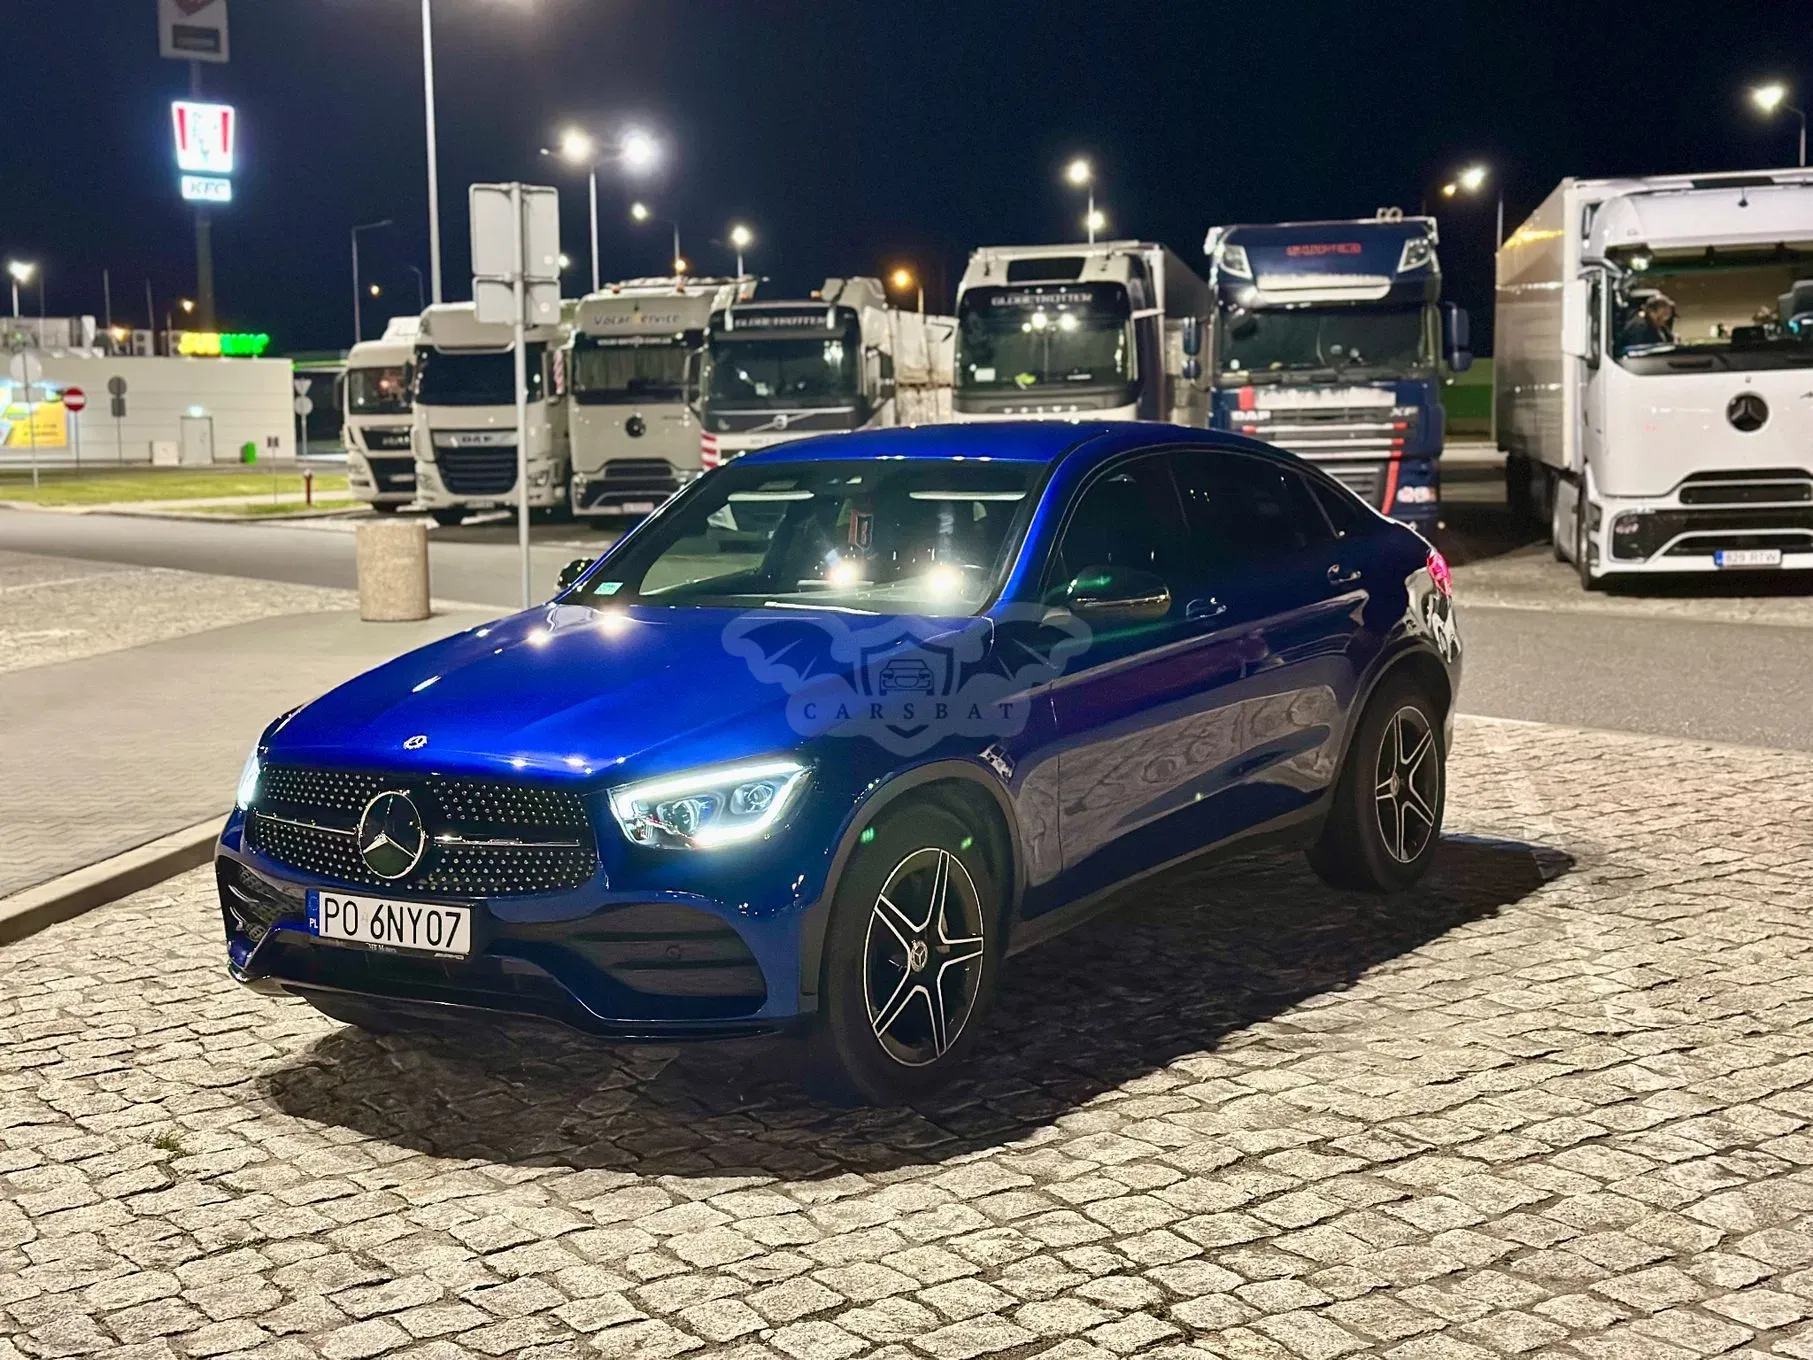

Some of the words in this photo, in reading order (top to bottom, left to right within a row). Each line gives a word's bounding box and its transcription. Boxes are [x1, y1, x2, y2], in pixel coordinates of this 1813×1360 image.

[191, 181, 226, 194] KFC
[309, 917, 318, 929] PL
[325, 897, 358, 936] PO
[370, 904, 461, 948] 6NY07
